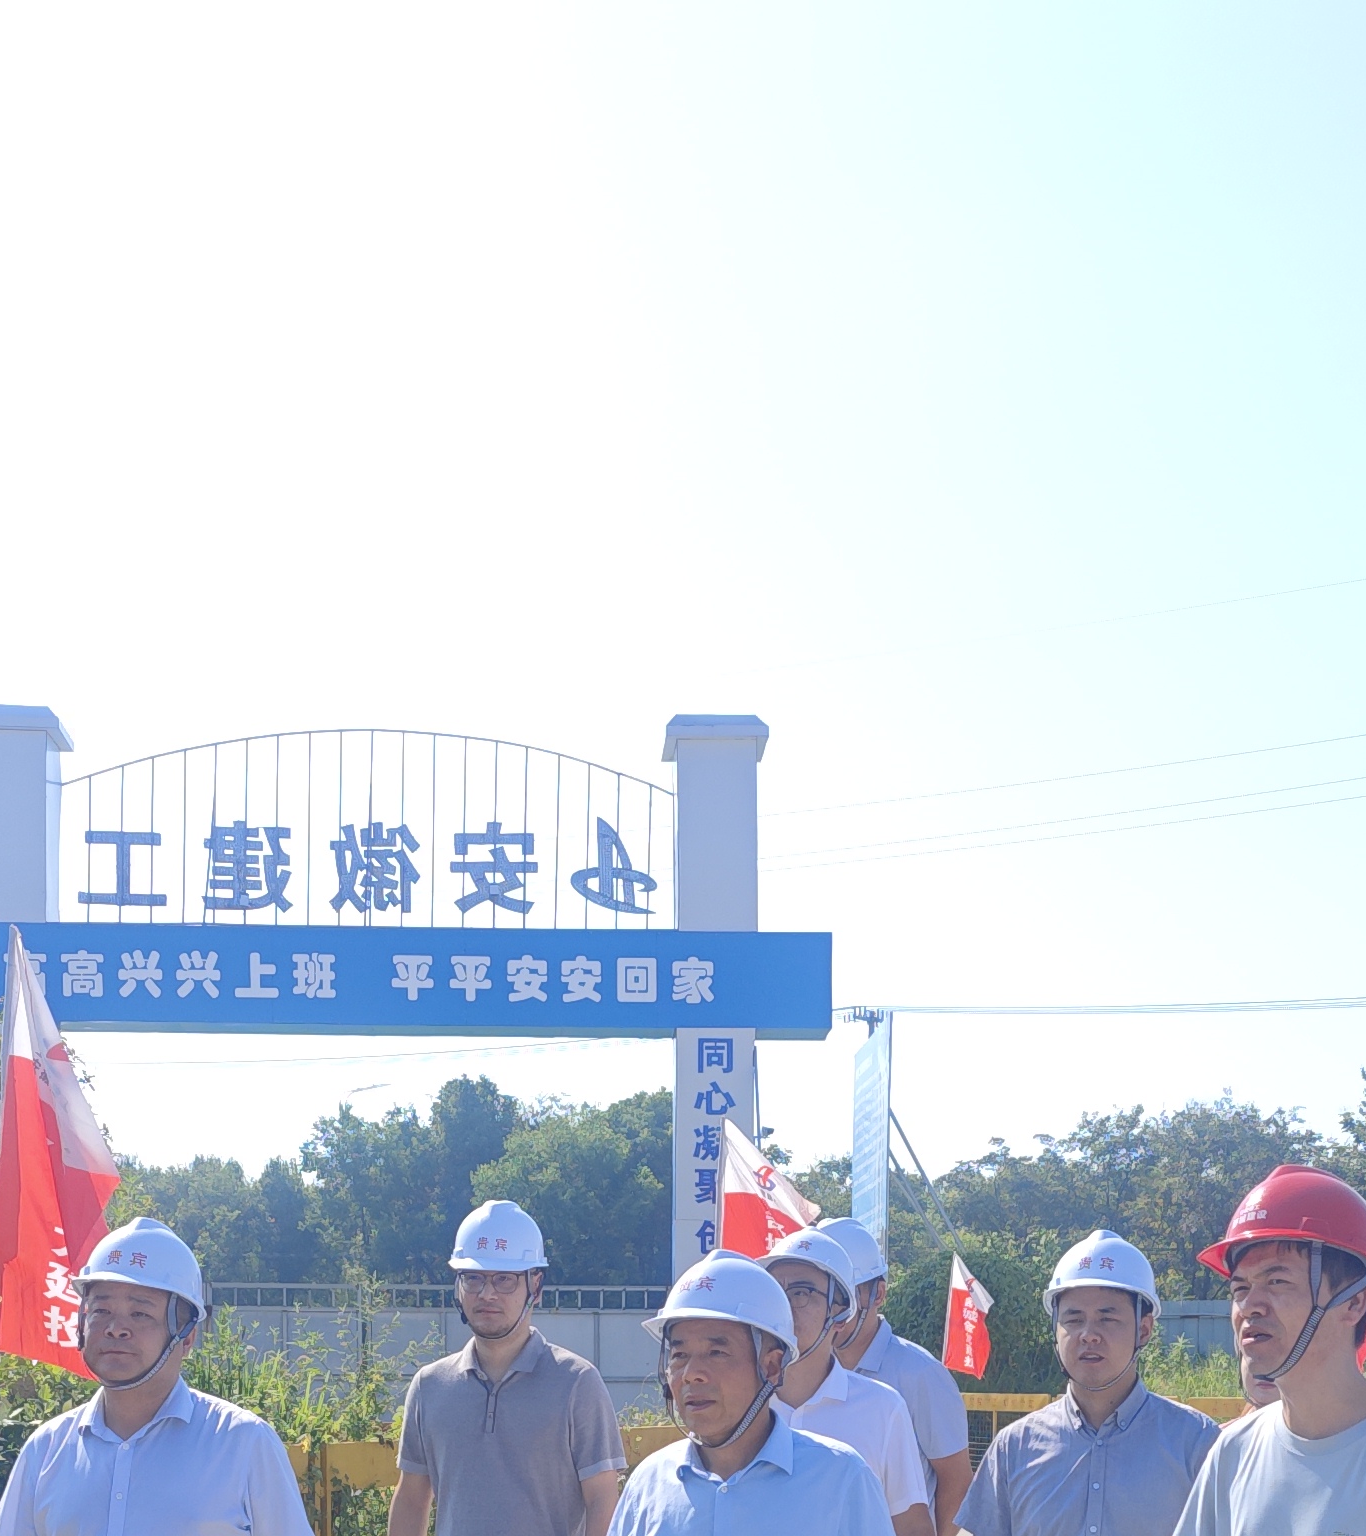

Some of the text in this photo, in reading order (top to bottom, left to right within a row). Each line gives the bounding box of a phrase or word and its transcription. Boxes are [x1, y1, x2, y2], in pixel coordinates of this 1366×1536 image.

[391, 954, 715, 1004] 平平安安回家
[477, 1236, 508, 1252] 贵宾
[107, 1250, 148, 1269] 贵宾
[1077, 1256, 1115, 1272] 贵宾
